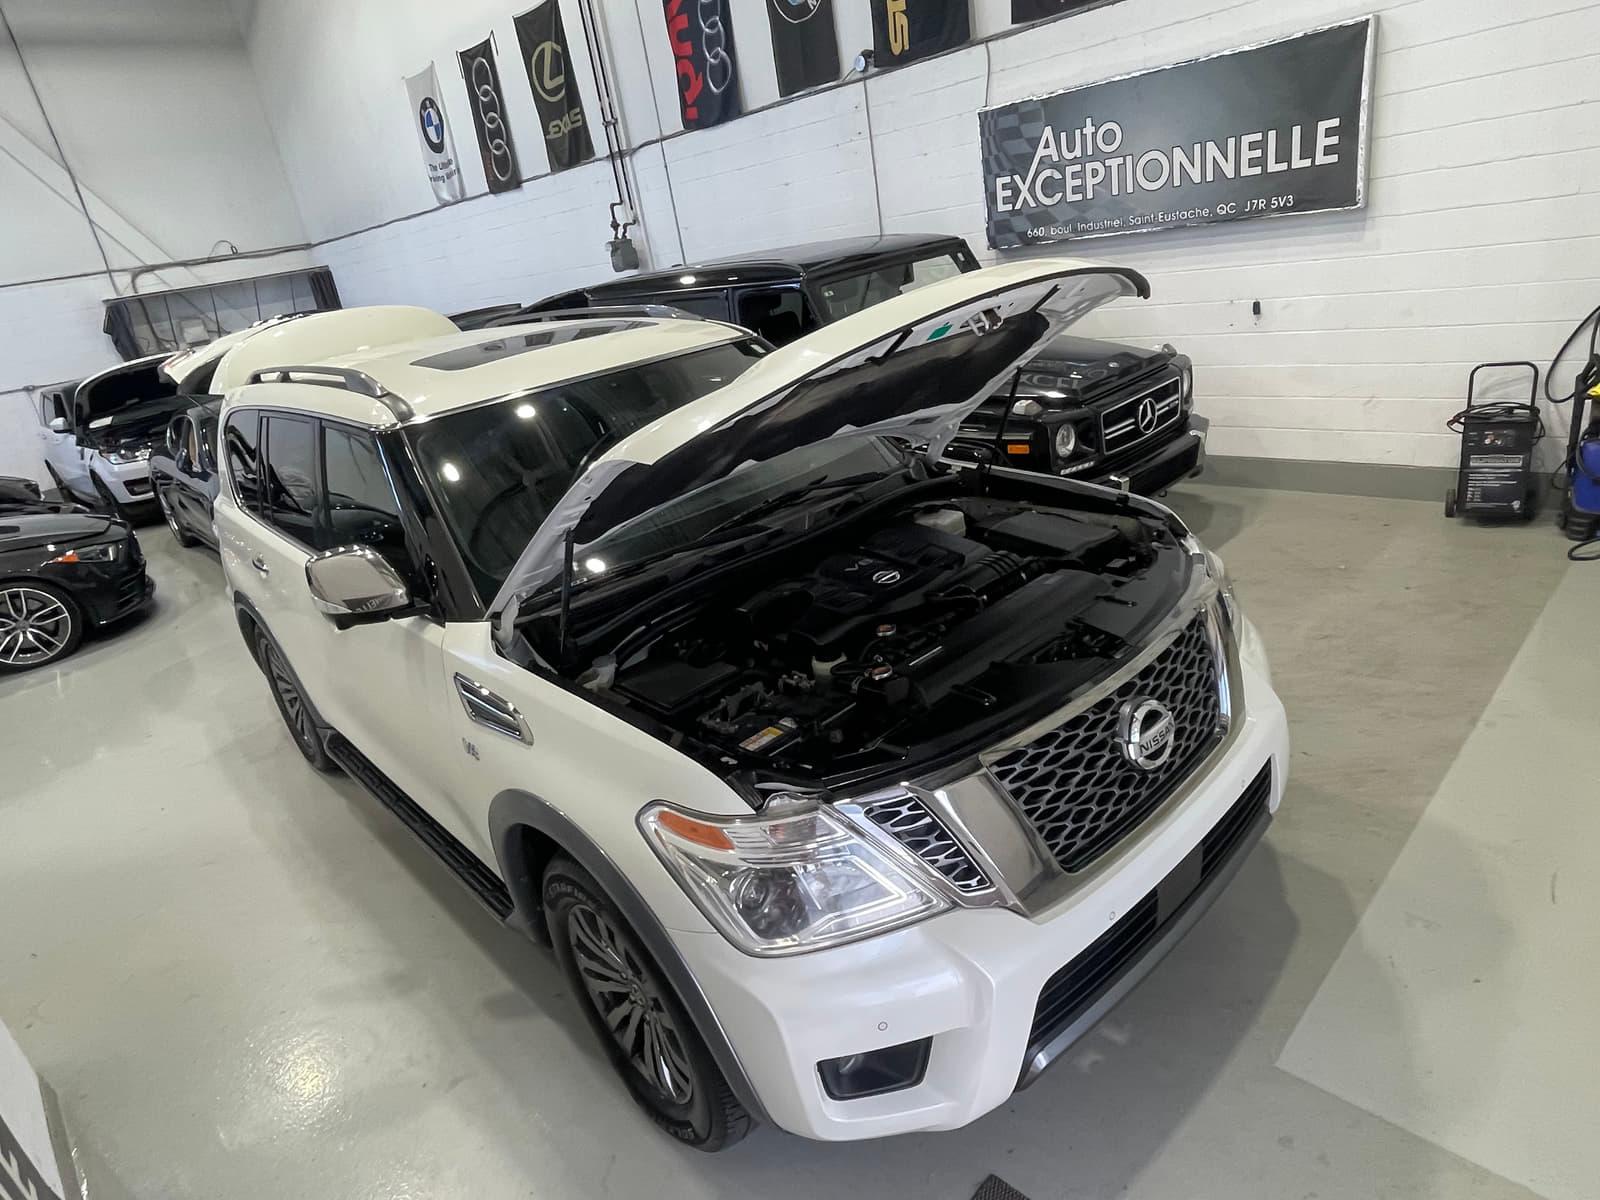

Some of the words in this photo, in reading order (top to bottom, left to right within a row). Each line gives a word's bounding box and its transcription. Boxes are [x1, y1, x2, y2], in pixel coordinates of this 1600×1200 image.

[1034, 117, 1123, 162] Auto
[996, 117, 1340, 212] EXCEPTIONNELLE
[1217, 203, 1236, 215] QC
[1244, 199, 1267, 212] J7R
[1271, 195, 1294, 209] 5V3
